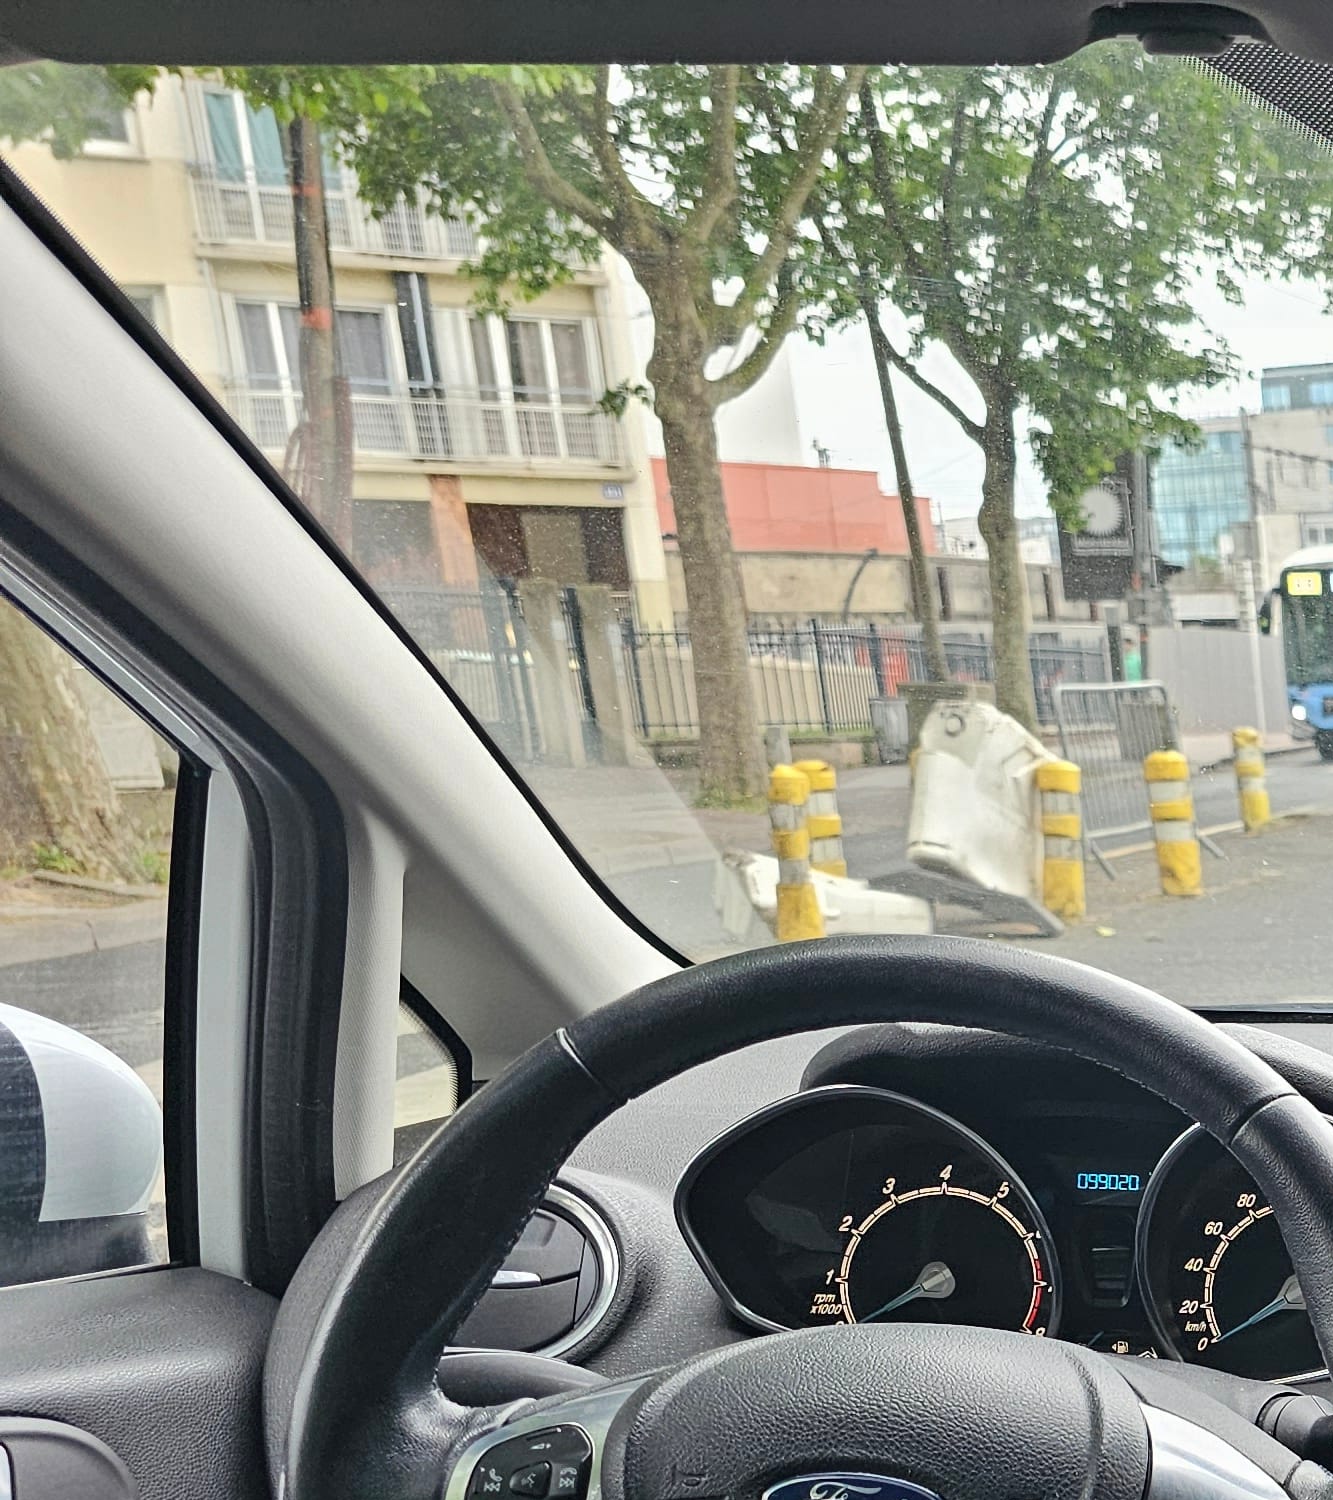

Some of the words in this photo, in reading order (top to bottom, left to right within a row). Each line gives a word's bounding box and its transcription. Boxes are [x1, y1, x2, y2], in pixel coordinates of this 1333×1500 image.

[939, 1165, 953, 1180] 4
[882, 1178, 896, 1194] 3
[1077, 1173, 1140, 1191] 099020
[996, 1182, 1010, 1198] 5
[1236, 1194, 1257, 1208] 80
[838, 1215, 853, 1232] 2
[1204, 1221, 1224, 1236] 60
[1184, 1258, 1204, 1272] 40
[825, 1269, 835, 1285] 1
[813, 1292, 836, 1304] rpm
[810, 1304, 843, 1315] x1000
[1179, 1300, 1199, 1314] 20
[1184, 1321, 1207, 1332] km/h
[1197, 1337, 1209, 1351] 0
